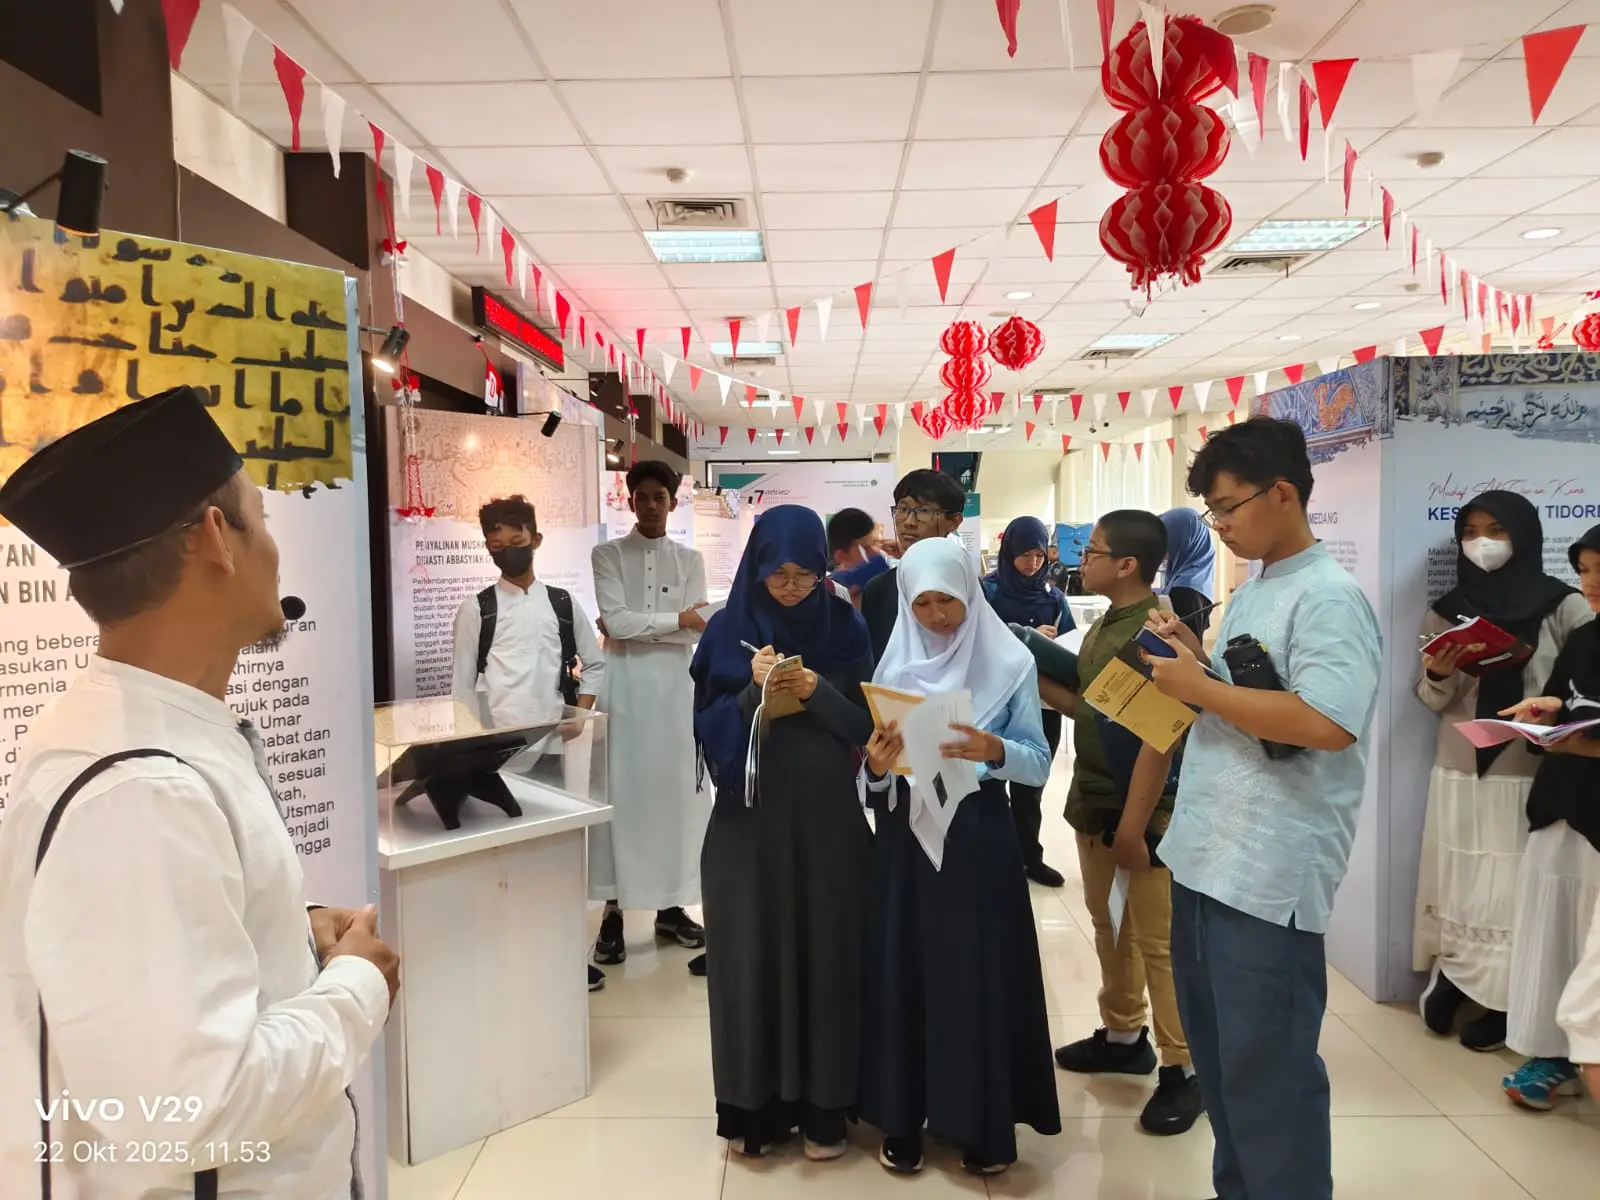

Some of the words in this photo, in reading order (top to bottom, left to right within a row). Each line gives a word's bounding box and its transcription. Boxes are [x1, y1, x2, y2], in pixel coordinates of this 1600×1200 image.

[1428, 507, 1461, 521] KES
[18, 579, 56, 603] BIN
[252, 675, 309, 692] dengan
[273, 693, 310, 711] pada
[260, 714, 302, 729] Umar
[303, 728, 331, 742] dan
[266, 747, 327, 766] rkirakan
[278, 762, 327, 784] sesuai
